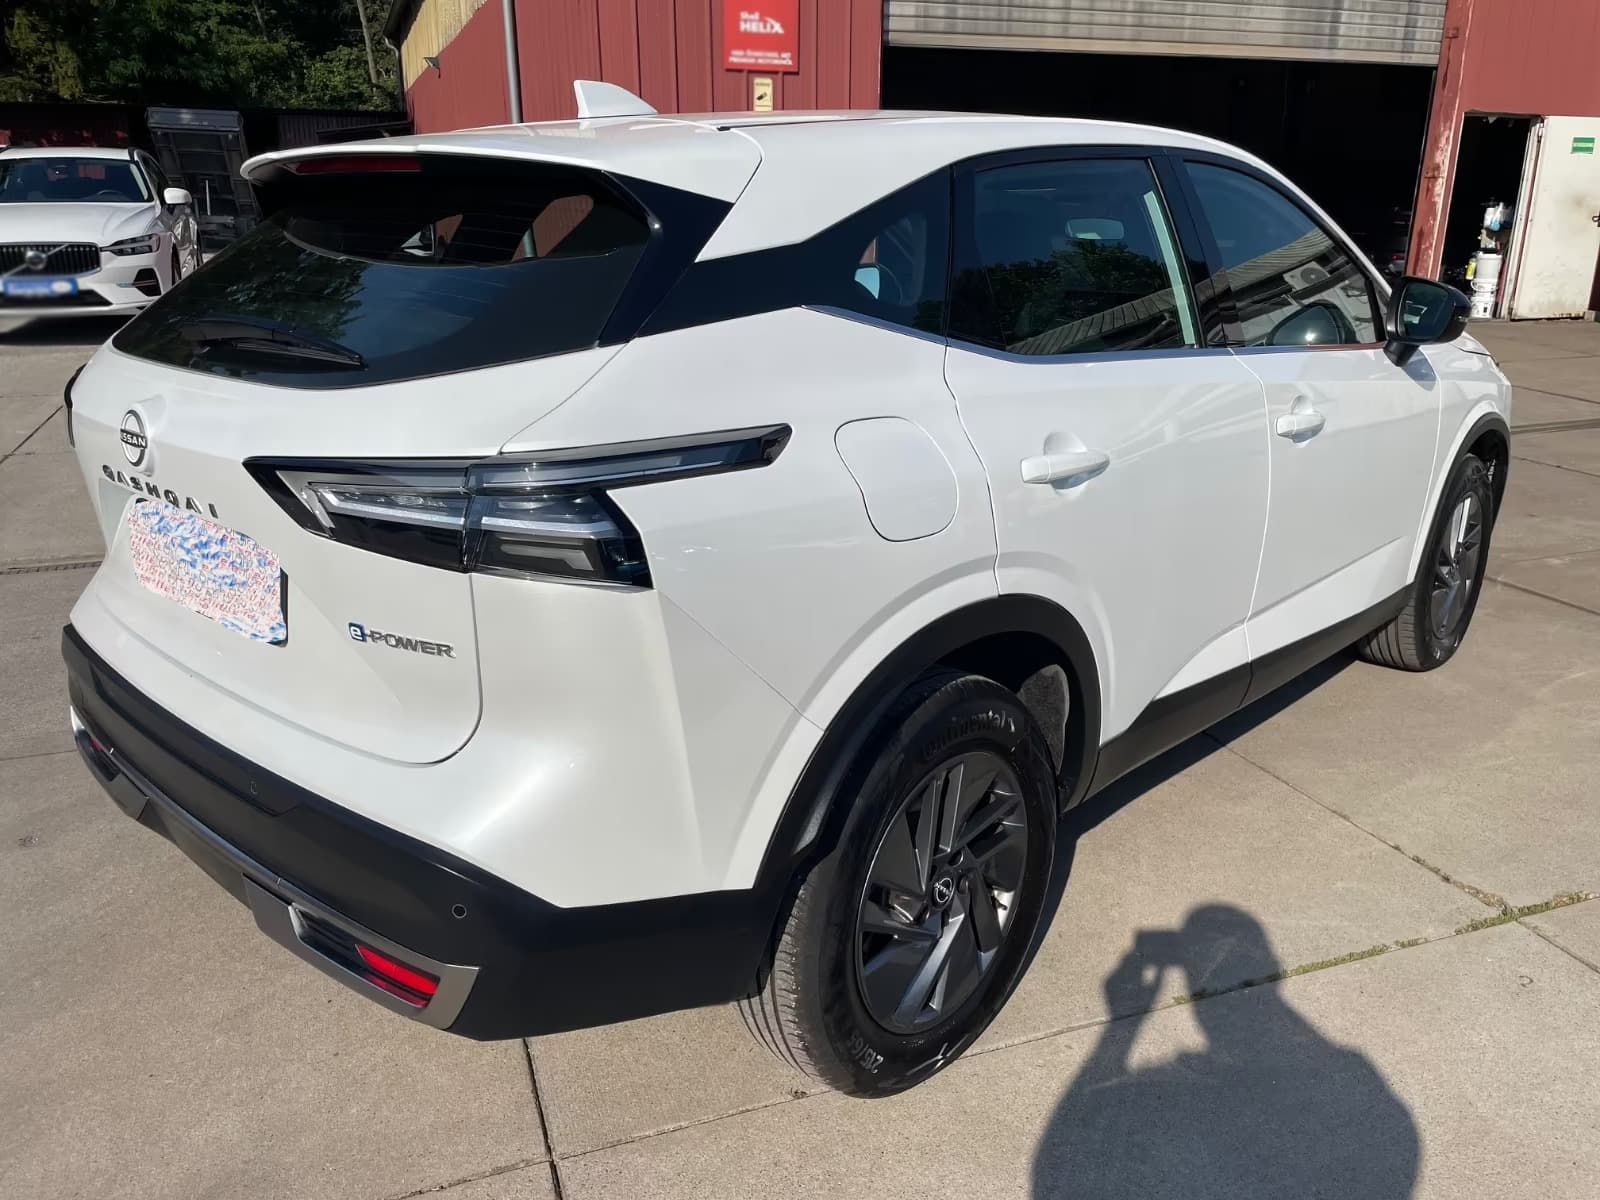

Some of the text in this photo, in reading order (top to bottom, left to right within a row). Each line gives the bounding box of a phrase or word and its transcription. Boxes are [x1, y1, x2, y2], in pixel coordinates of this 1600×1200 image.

[121, 431, 147, 448] SSAN
[102, 464, 219, 519] QASHQAI
[348, 621, 457, 660] e-POWER
